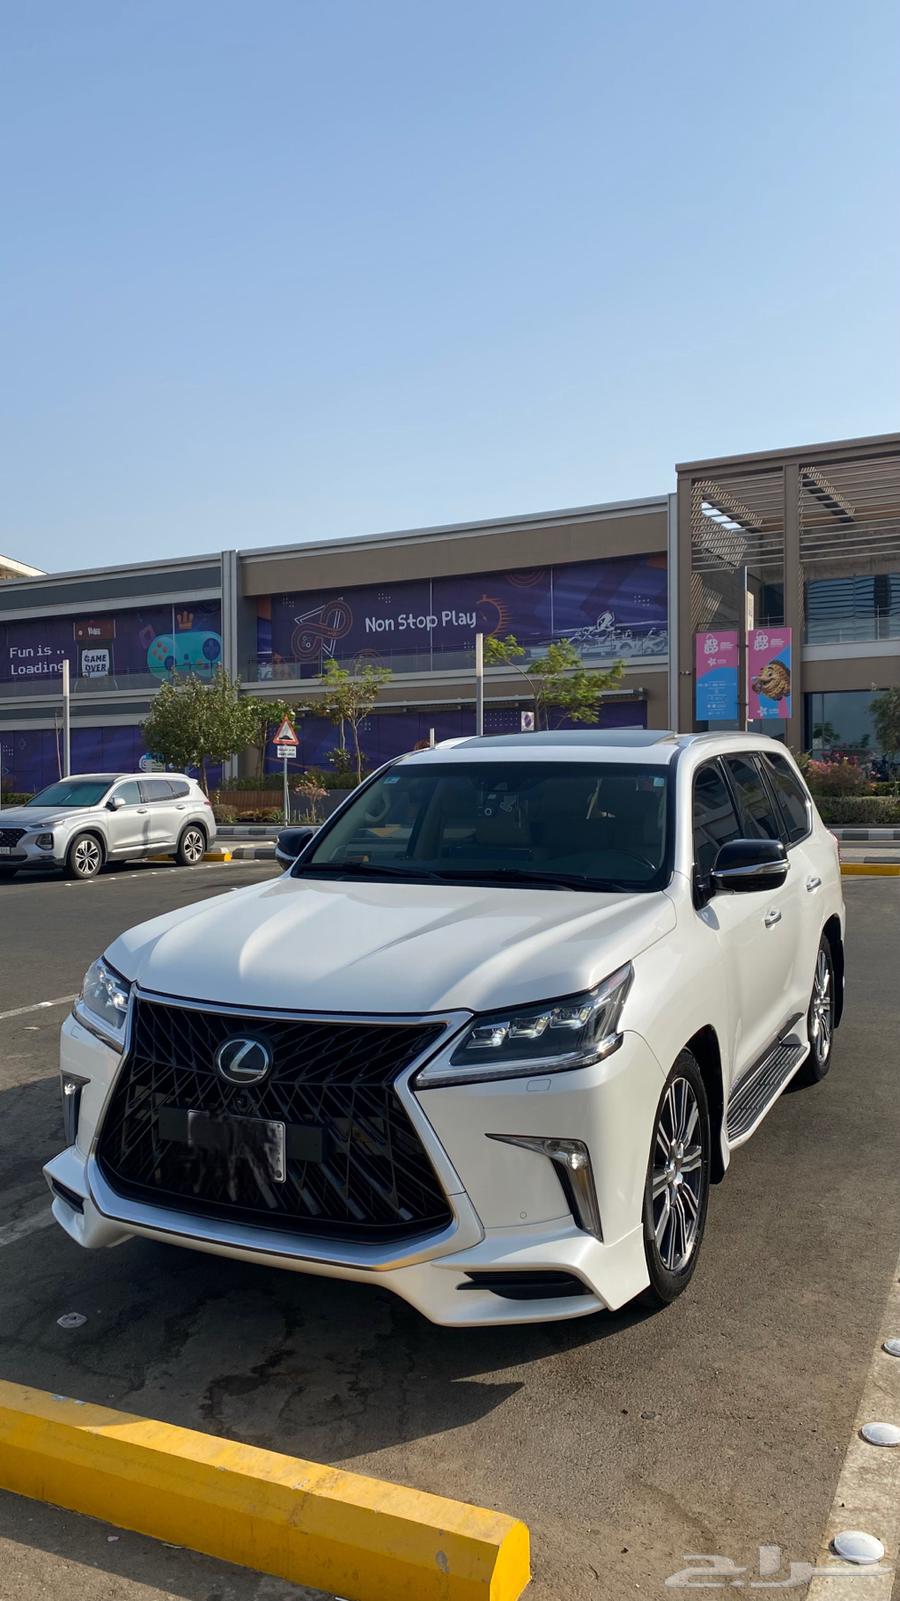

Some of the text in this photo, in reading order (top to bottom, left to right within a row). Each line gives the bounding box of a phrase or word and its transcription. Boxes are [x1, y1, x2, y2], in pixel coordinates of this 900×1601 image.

[365, 610, 477, 632] Non Stop Play
[10, 647, 34, 658] Fun
[36, 645, 52, 656] is
[84, 655, 107, 663] GAME
[11, 662, 64, 675] Loading
[85, 664, 106, 672] OVER
